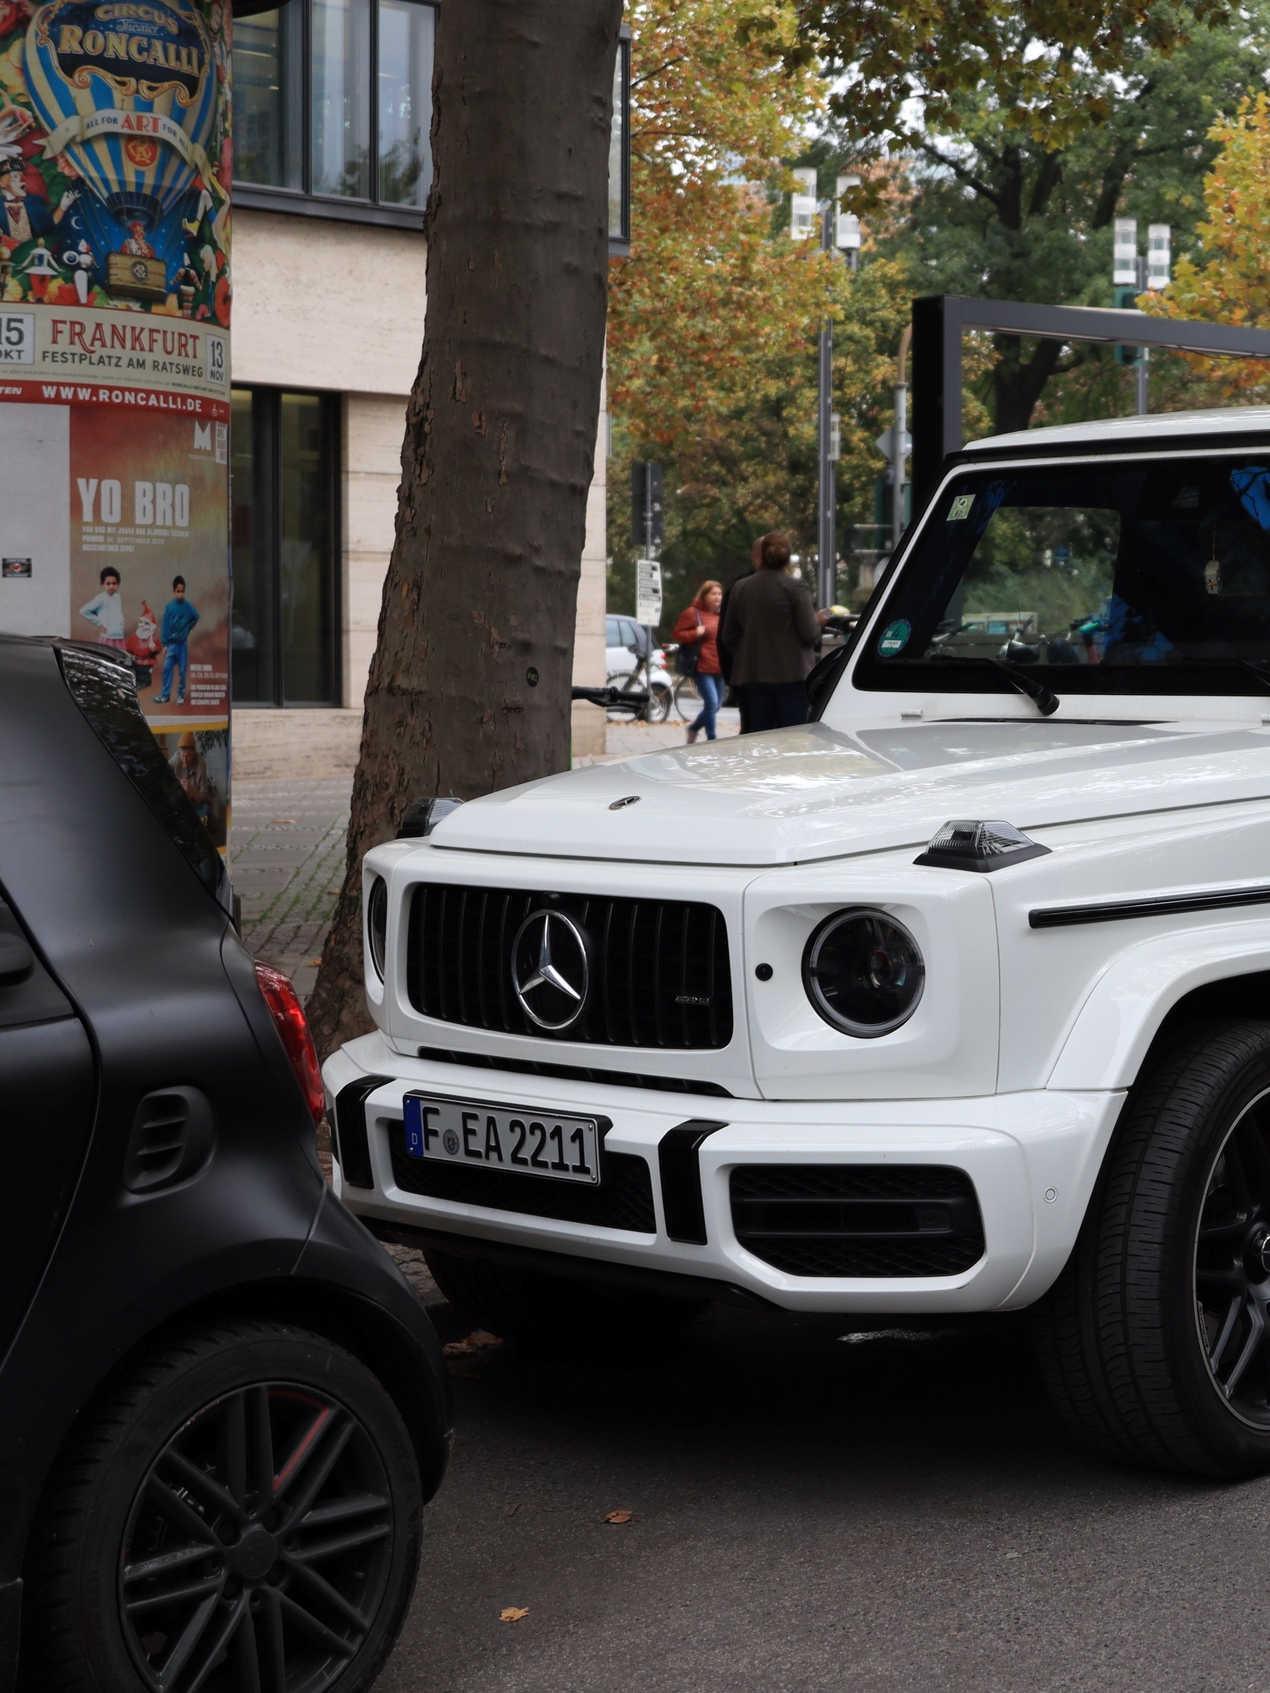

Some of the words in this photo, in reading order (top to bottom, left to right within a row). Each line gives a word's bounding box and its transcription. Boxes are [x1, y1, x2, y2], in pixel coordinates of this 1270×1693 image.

[95, 3, 179, 35] CIRCUS
[58, 24, 200, 78] RONCALLI
[86, 119, 99, 130] ALL
[101, 116, 119, 125] FOR
[121, 113, 161, 133] ART
[163, 123, 178, 138] FOR
[51, 318, 200, 359] FRANKFURT
[42, 350, 122, 368] FESTPLATZ
[127, 357, 146, 370] AM
[152, 360, 203, 378] RATSWEG
[211, 340, 224, 369] 13
[210, 369, 225, 382] NOV
[42, 385, 202, 412] WWW.RONCALLI.DE
[77, 478, 121, 523] YO
[135, 481, 190, 527] BRO
[411, 1132, 418, 1145] D
